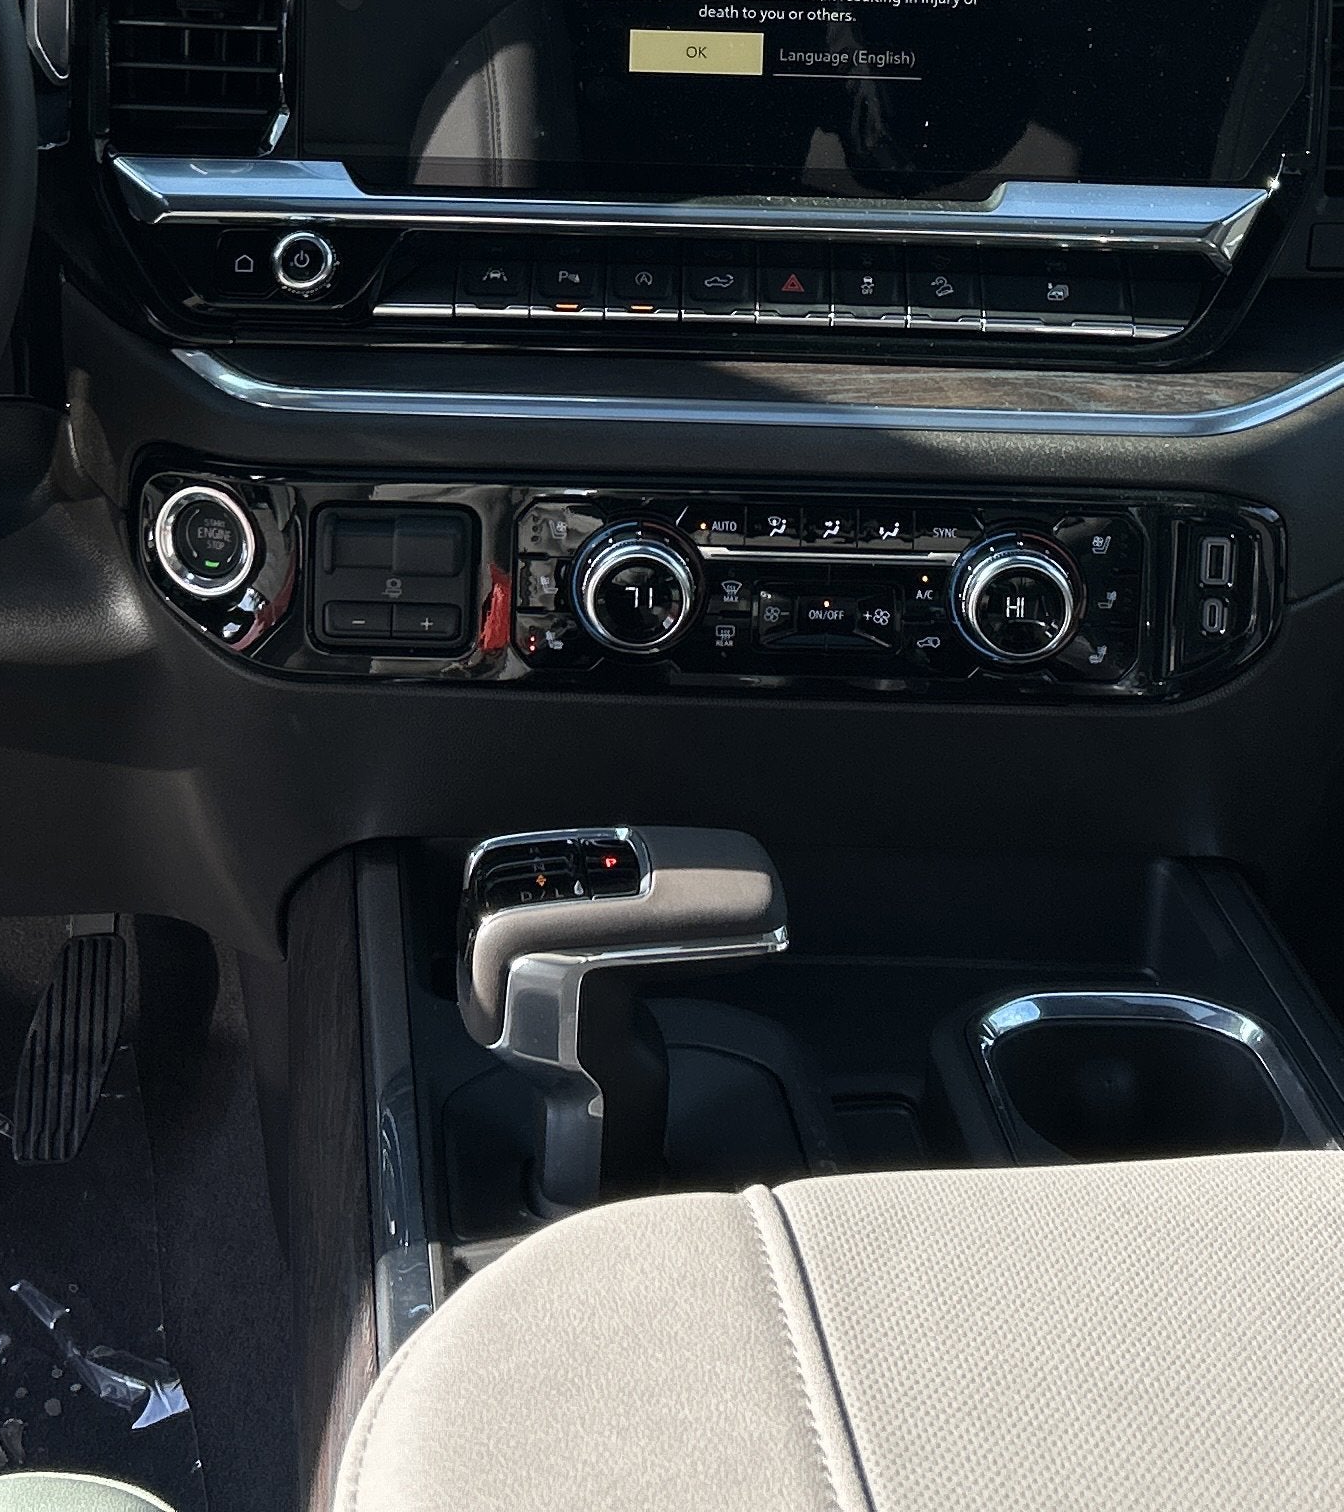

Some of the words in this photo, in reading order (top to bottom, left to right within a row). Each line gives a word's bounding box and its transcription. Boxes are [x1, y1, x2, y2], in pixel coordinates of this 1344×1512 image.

[698, 4, 739, 19] death
[742, 7, 757, 19] to
[759, 9, 785, 23] you
[788, 10, 805, 21] or
[806, 7, 857, 22] others.
[685, 45, 707, 59] OK
[779, 48, 849, 65] Language
[852, 49, 916, 68] (English)
[711, 521, 738, 532] AUTO
[932, 527, 958, 539] SYNC
[197, 526, 233, 542] ENGINE
[915, 589, 934, 601] A/C
[1006, 596, 1025, 618] HI
[808, 609, 845, 621] ON/OFF
[605, 857, 617, 868] P
